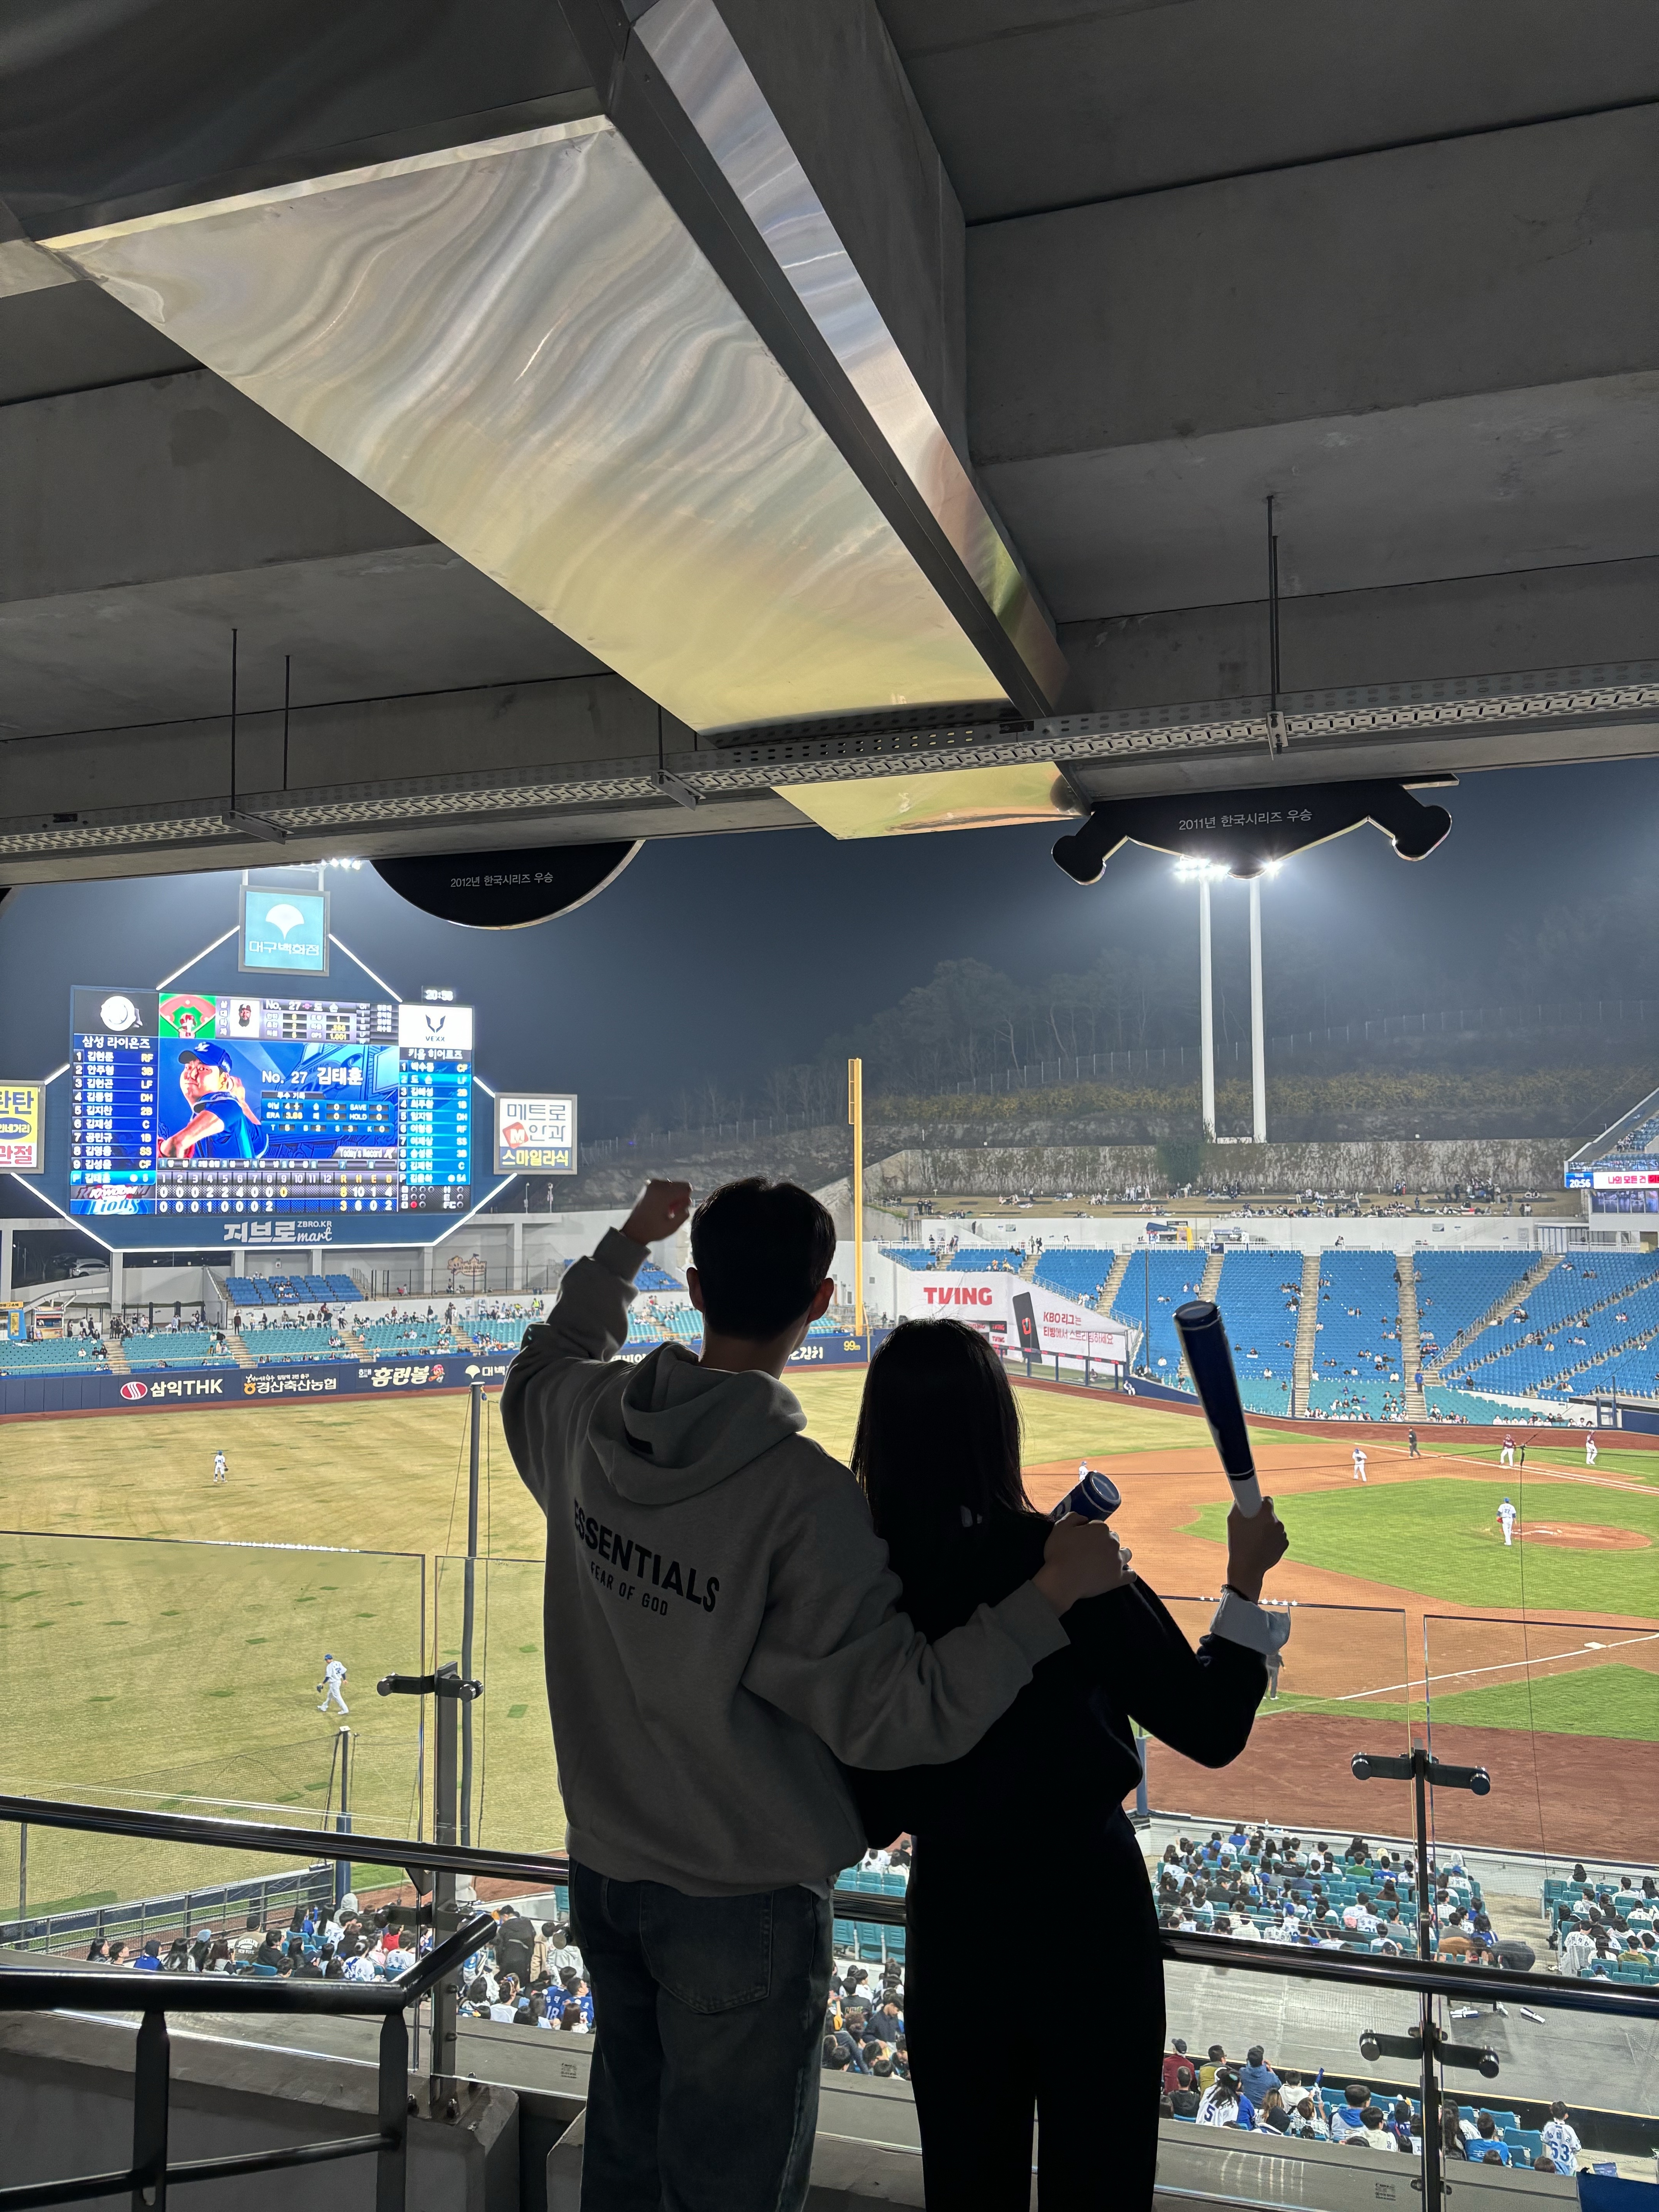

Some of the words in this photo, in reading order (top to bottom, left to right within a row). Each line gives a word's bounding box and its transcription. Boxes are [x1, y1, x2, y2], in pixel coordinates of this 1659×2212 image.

[1179, 817, 1216, 830] 2011년
[1221, 812, 1282, 827] 한국시리즈
[1286, 809, 1312, 822] 우승
[450, 876, 480, 887] 2012년
[484, 874, 531, 886] 한국시리즈
[534, 872, 553, 883] 우승
[249, 941, 319, 956] 대구백화점
[266, 1000, 281, 1010] No.
[289, 1001, 301, 1010] 27
[82, 1036, 104, 1048] 삼성
[107, 1037, 150, 1049] 라이온즈
[77, 1052, 81, 1061] 1
[409, 1048, 426, 1060] 키움
[76, 1065, 82, 1074] 2
[262, 1070, 284, 1084] No.
[291, 1072, 307, 1084] 27
[317, 1067, 363, 1085] 김태훈
[75, 1079, 82, 1088] 3
[141, 1080, 153, 1089] LF
[75, 1092, 82, 1101] 4
[141, 1093, 153, 1102] DH
[75, 1106, 81, 1115] 5
[141, 1107, 153, 1116] 2B
[507, 1104, 566, 1121] 메트로
[74, 1119, 81, 1128] 6
[142, 1120, 149, 1129] C
[74, 1133, 81, 1142] 7
[141, 1133, 151, 1142] 1B
[510, 1128, 525, 1144] M
[529, 1125, 566, 1142] 안과
[0, 1145, 32, 1164] 관절
[74, 1146, 81, 1156] 8
[140, 1147, 152, 1156] SS
[502, 1149, 568, 1166] 스마일라식
[73, 1160, 81, 1169] 9
[139, 1160, 151, 1169] CF
[458, 1162, 465, 1170] C
[73, 1174, 80, 1182] P
[162, 1174, 165, 1183] 1
[177, 1174, 182, 1183] 2
[192, 1174, 198, 1183] 3
[207, 1174, 213, 1183] 4
[223, 1174, 228, 1183] 5
[237, 1174, 243, 1183] 6
[252, 1174, 258, 1183] 7
[267, 1174, 272, 1183] 8
[281, 1174, 287, 1183] 9
[295, 1174, 303, 1183] 10
[309, 1174, 316, 1183] 11
[323, 1174, 331, 1183] 12
[340, 1174, 347, 1183] R
[371, 1174, 376, 1183] E
[1570, 1179, 1590, 1188] 20:56
[160, 1187, 168, 1198] 0
[176, 1187, 184, 1198] 0
[191, 1187, 199, 1198] 0
[206, 1187, 214, 1198] 2
[222, 1187, 228, 1198] 2
[236, 1187, 244, 1198] 4
[251, 1187, 259, 1198] 0
[266, 1187, 273, 1198] 0
[280, 1186, 287, 1197] 0
[340, 1186, 347, 1197] 8
[353, 1186, 365, 1197] 10
[371, 1186, 376, 1197] 1
[385, 1186, 392, 1197] 4
[160, 1201, 167, 1212] 0
[175, 1201, 184, 1212] 0
[191, 1201, 199, 1212] 0
[206, 1201, 212, 1212] 1
[221, 1201, 228, 1212] 0
[236, 1201, 244, 1212] 0
[251, 1201, 258, 1212] 0
[266, 1201, 273, 1212] 2
[340, 1200, 347, 1211] 3
[370, 1200, 377, 1211] 0
[385, 1200, 392, 1211] 2
[224, 1221, 296, 1243] 지브로
[297, 1227, 332, 1242] mart
[923, 1287, 992, 1306] TVING
[1043, 1326, 1068, 1340] 티빙에서
[1069, 1329, 1113, 1345] 스트리밍하세요
[844, 1340, 860, 1351] 99m
[371, 1365, 429, 1387] 홈런볼
[482, 1365, 509, 1376] 대백
[150, 1379, 223, 1397] 삼익THK
[256, 1378, 336, 1394] 경산축산농협
[574, 1498, 720, 1612] ESSENTIALS
[591, 1561, 613, 1590] FEAR
[619, 1582, 635, 1600] OF
[642, 1593, 668, 1616] GOD
[546, 2006, 559, 2020] 18
[1204, 2104, 1215, 2122] 5
